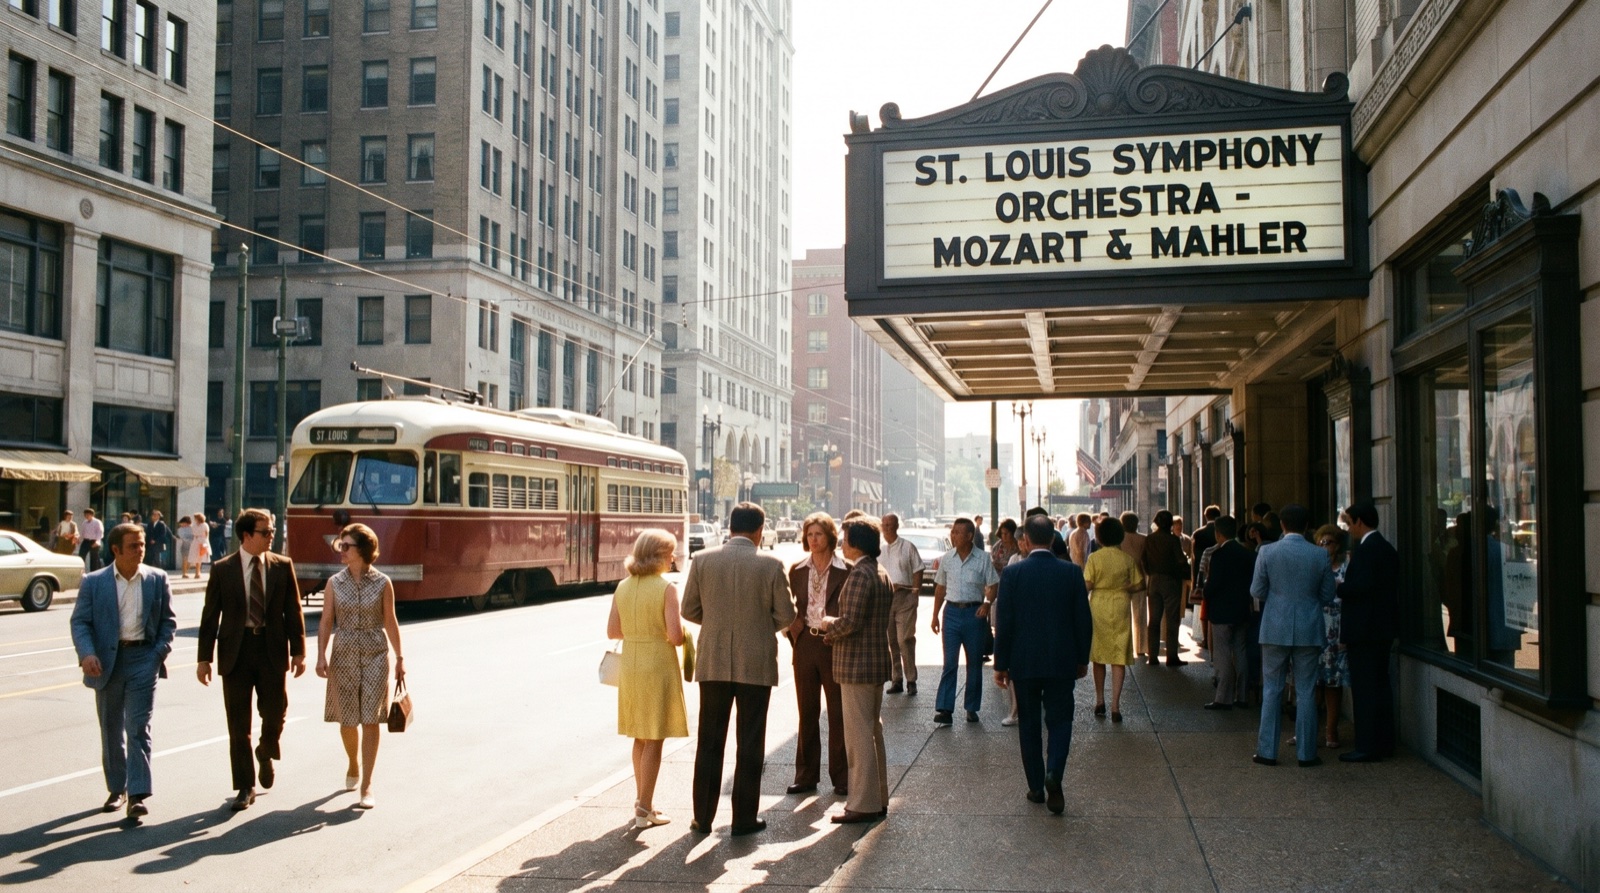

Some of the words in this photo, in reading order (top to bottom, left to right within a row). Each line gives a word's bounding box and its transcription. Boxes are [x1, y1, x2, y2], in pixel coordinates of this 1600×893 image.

[915, 154, 967, 185] ST.
[985, 147, 1091, 182] LOUIS
[1113, 133, 1322, 175] SYMPHONY
[996, 182, 1221, 223] ORCHESTRA
[934, 231, 1088, 268] MOZART
[1106, 229, 1132, 260] &
[1151, 221, 1308, 259] MAHLER
[328, 430, 348, 441] LOUIS
